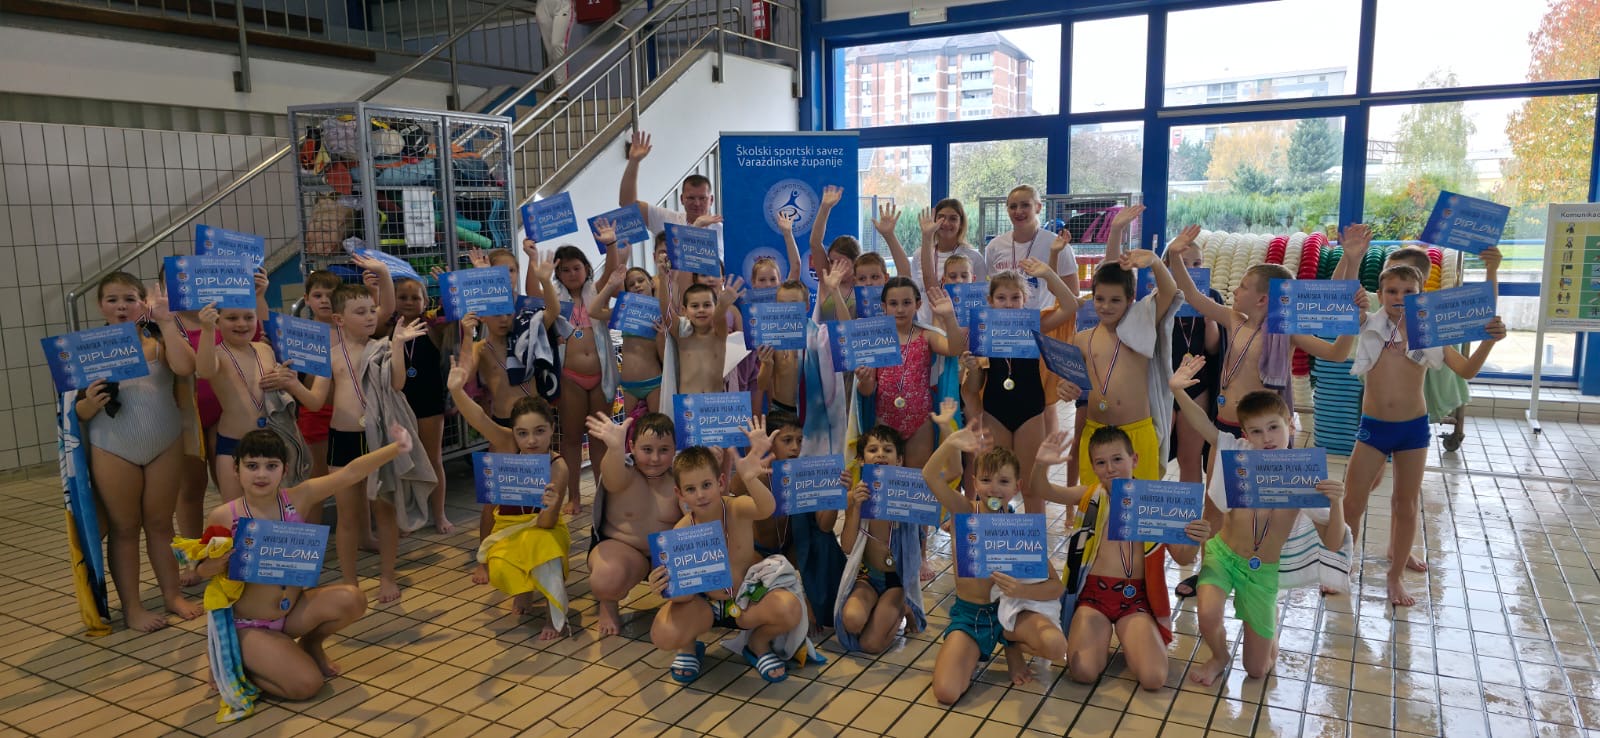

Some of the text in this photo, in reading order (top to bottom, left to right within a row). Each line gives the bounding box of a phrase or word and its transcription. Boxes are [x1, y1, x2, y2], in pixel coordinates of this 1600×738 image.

[736, 144, 771, 156] Školski
[774, 146, 814, 157] sportski
[738, 156, 843, 168] Varaždinske županije
[616, 219, 641, 231] PLOMA
[1454, 217, 1499, 235] DIPLOMA
[682, 244, 715, 256] DIPLOMA
[195, 277, 250, 287] DIPLOMA
[464, 287, 508, 297] DIPLOMA
[1296, 302, 1354, 313] DIPLOMA
[1434, 306, 1493, 322] DIPLOMA
[761, 322, 803, 331] DIPLOMA
[286, 338, 327, 354] DIPLOMA
[852, 336, 896, 348] DIPLOMA
[79, 345, 138, 364] DIPLOMA
[699, 415, 749, 425] DIPLOMA
[498, 475, 546, 487] DIPLOMA
[1256, 475, 1321, 486] DIPLOMA
[888, 488, 938, 502] DIPLOMA
[1138, 505, 1197, 519] DIPLOMA
[985, 540, 1043, 552] DIPLOMA
[260, 547, 320, 560] DIPLOMA
[674, 549, 724, 567] DIPLOMA
